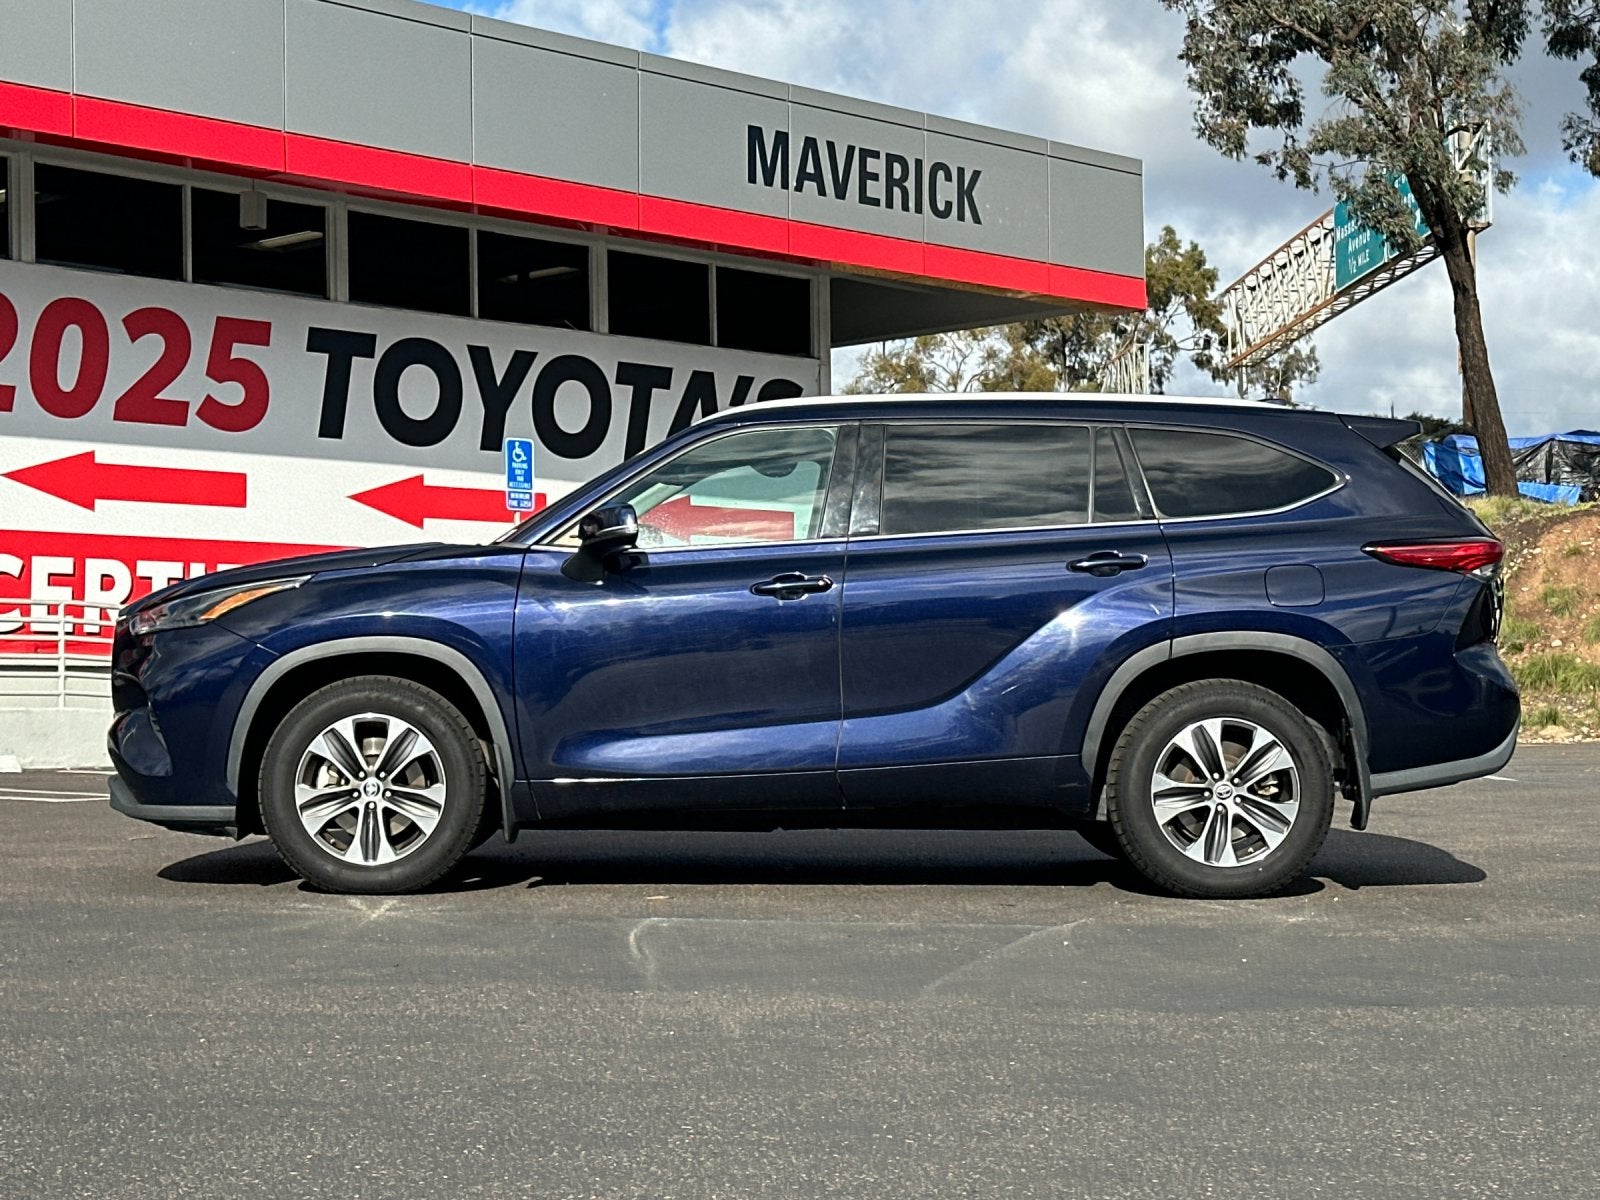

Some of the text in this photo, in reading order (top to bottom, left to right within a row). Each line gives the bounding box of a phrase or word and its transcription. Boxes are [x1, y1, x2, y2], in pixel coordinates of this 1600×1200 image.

[747, 124, 983, 226] MAVERICK
[1348, 229, 1370, 254] Avenue
[1358, 248, 1370, 267] MILE
[0, 296, 271, 433] 025
